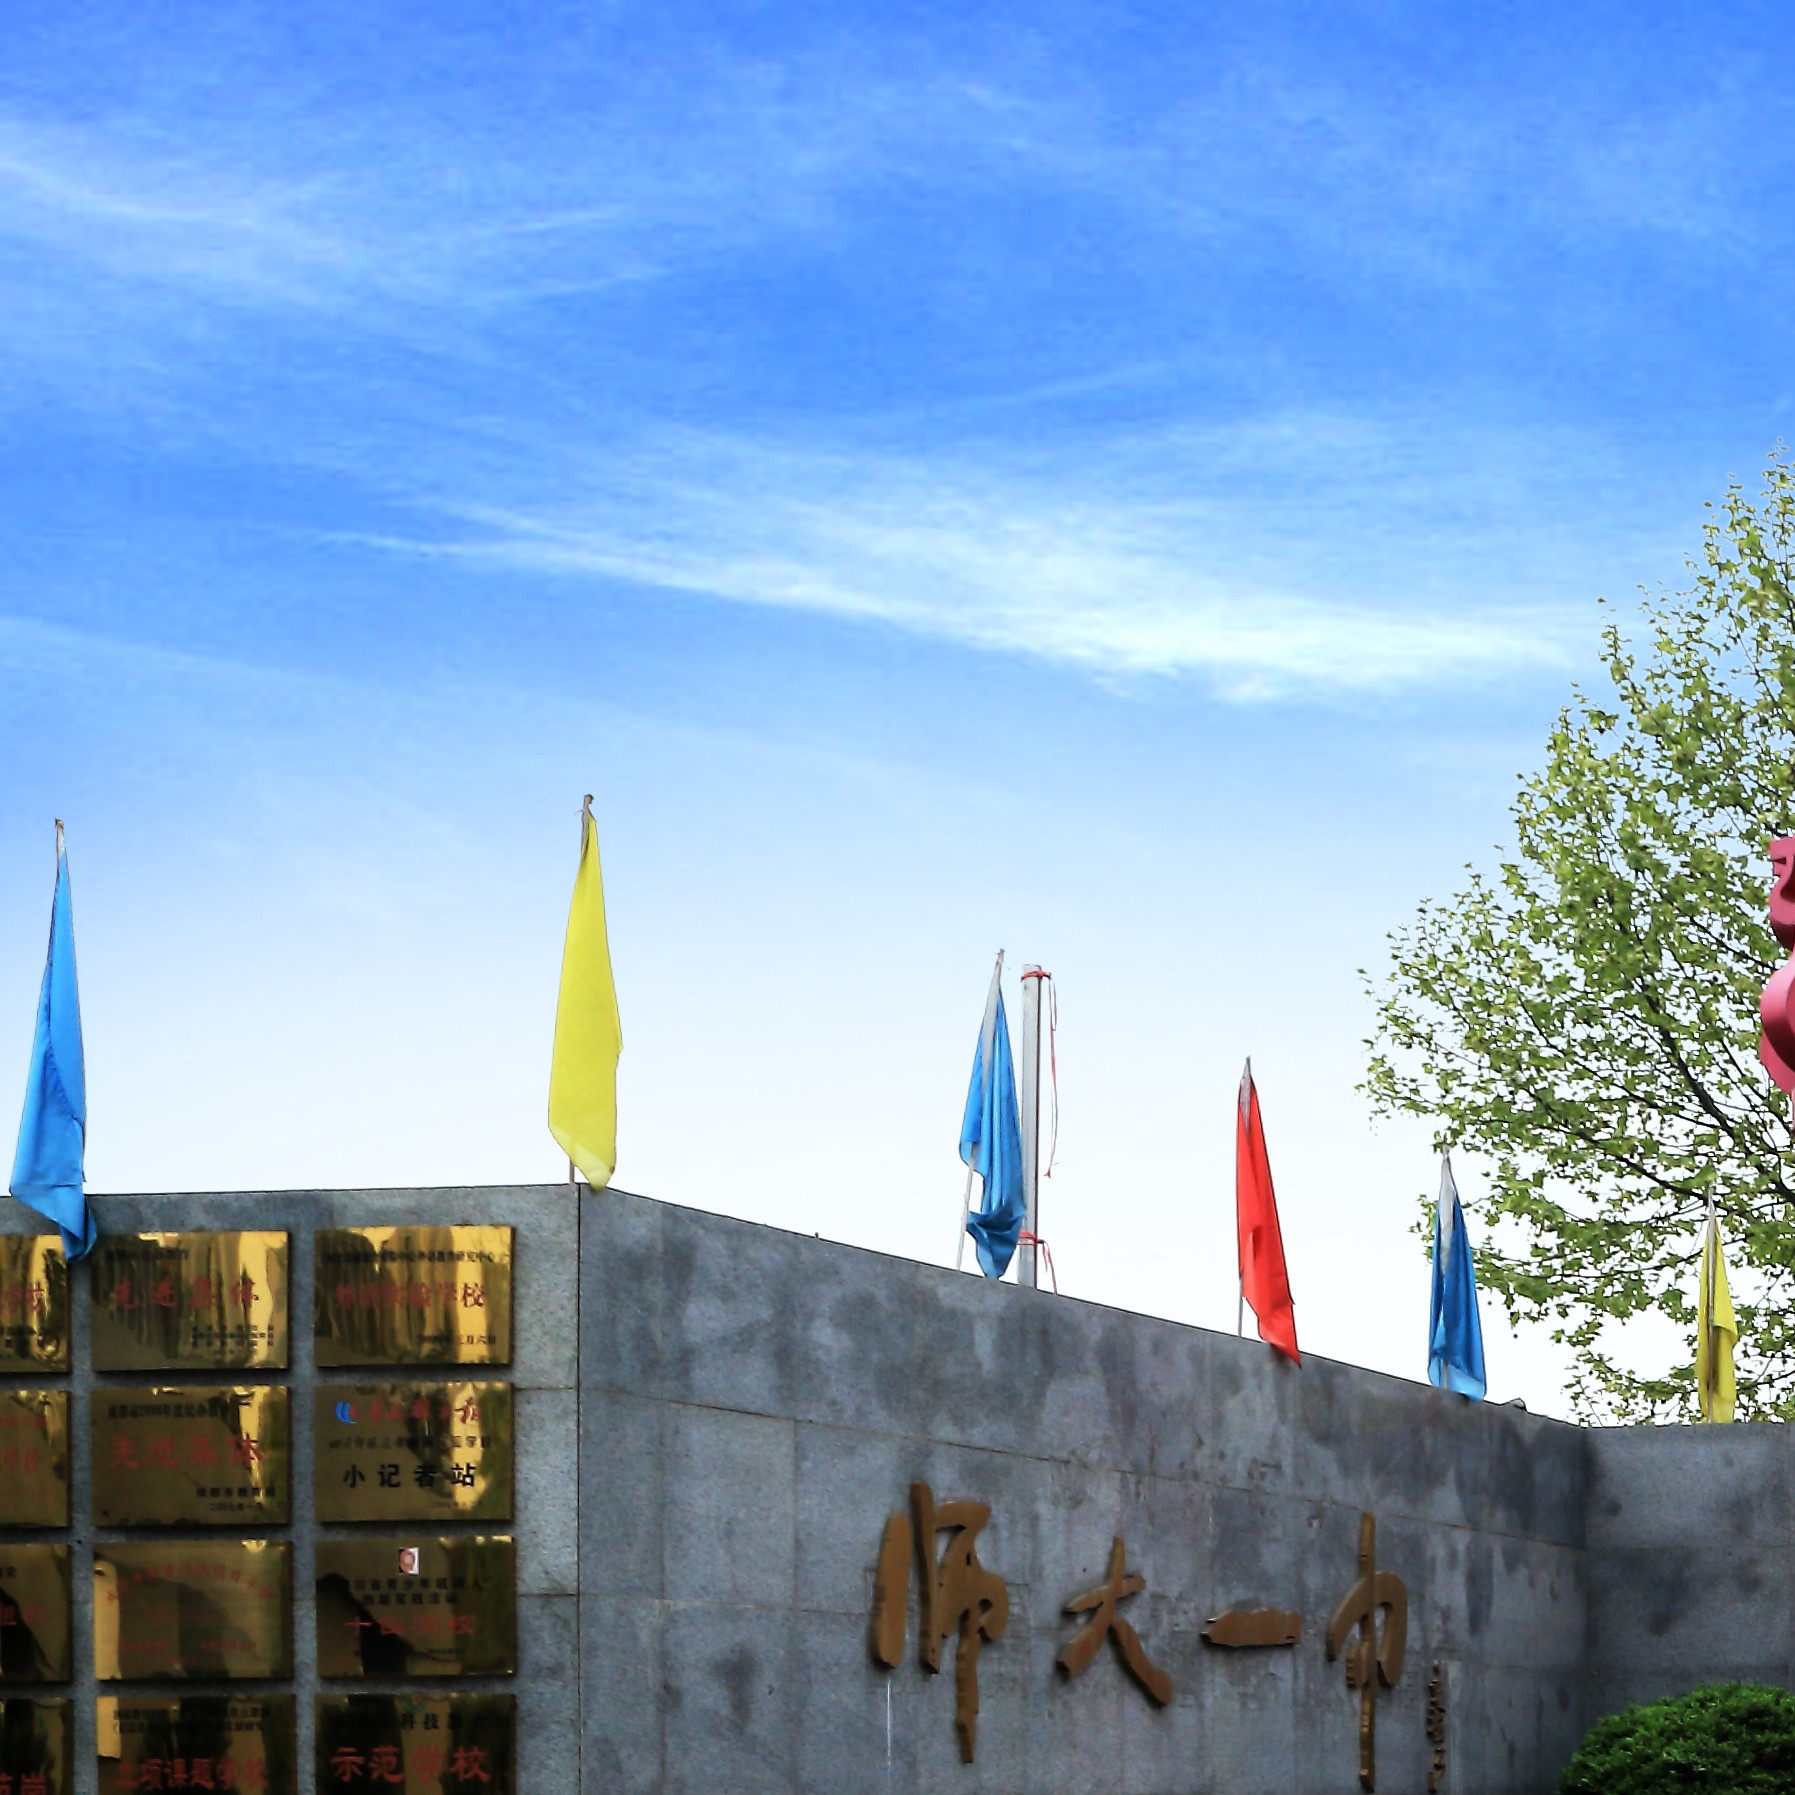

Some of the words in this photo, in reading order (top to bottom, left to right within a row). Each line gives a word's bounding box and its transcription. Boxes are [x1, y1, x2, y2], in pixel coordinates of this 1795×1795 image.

[344, 1462, 477, 1489] 小记者站
[331, 1745, 492, 1785] 示范学校
